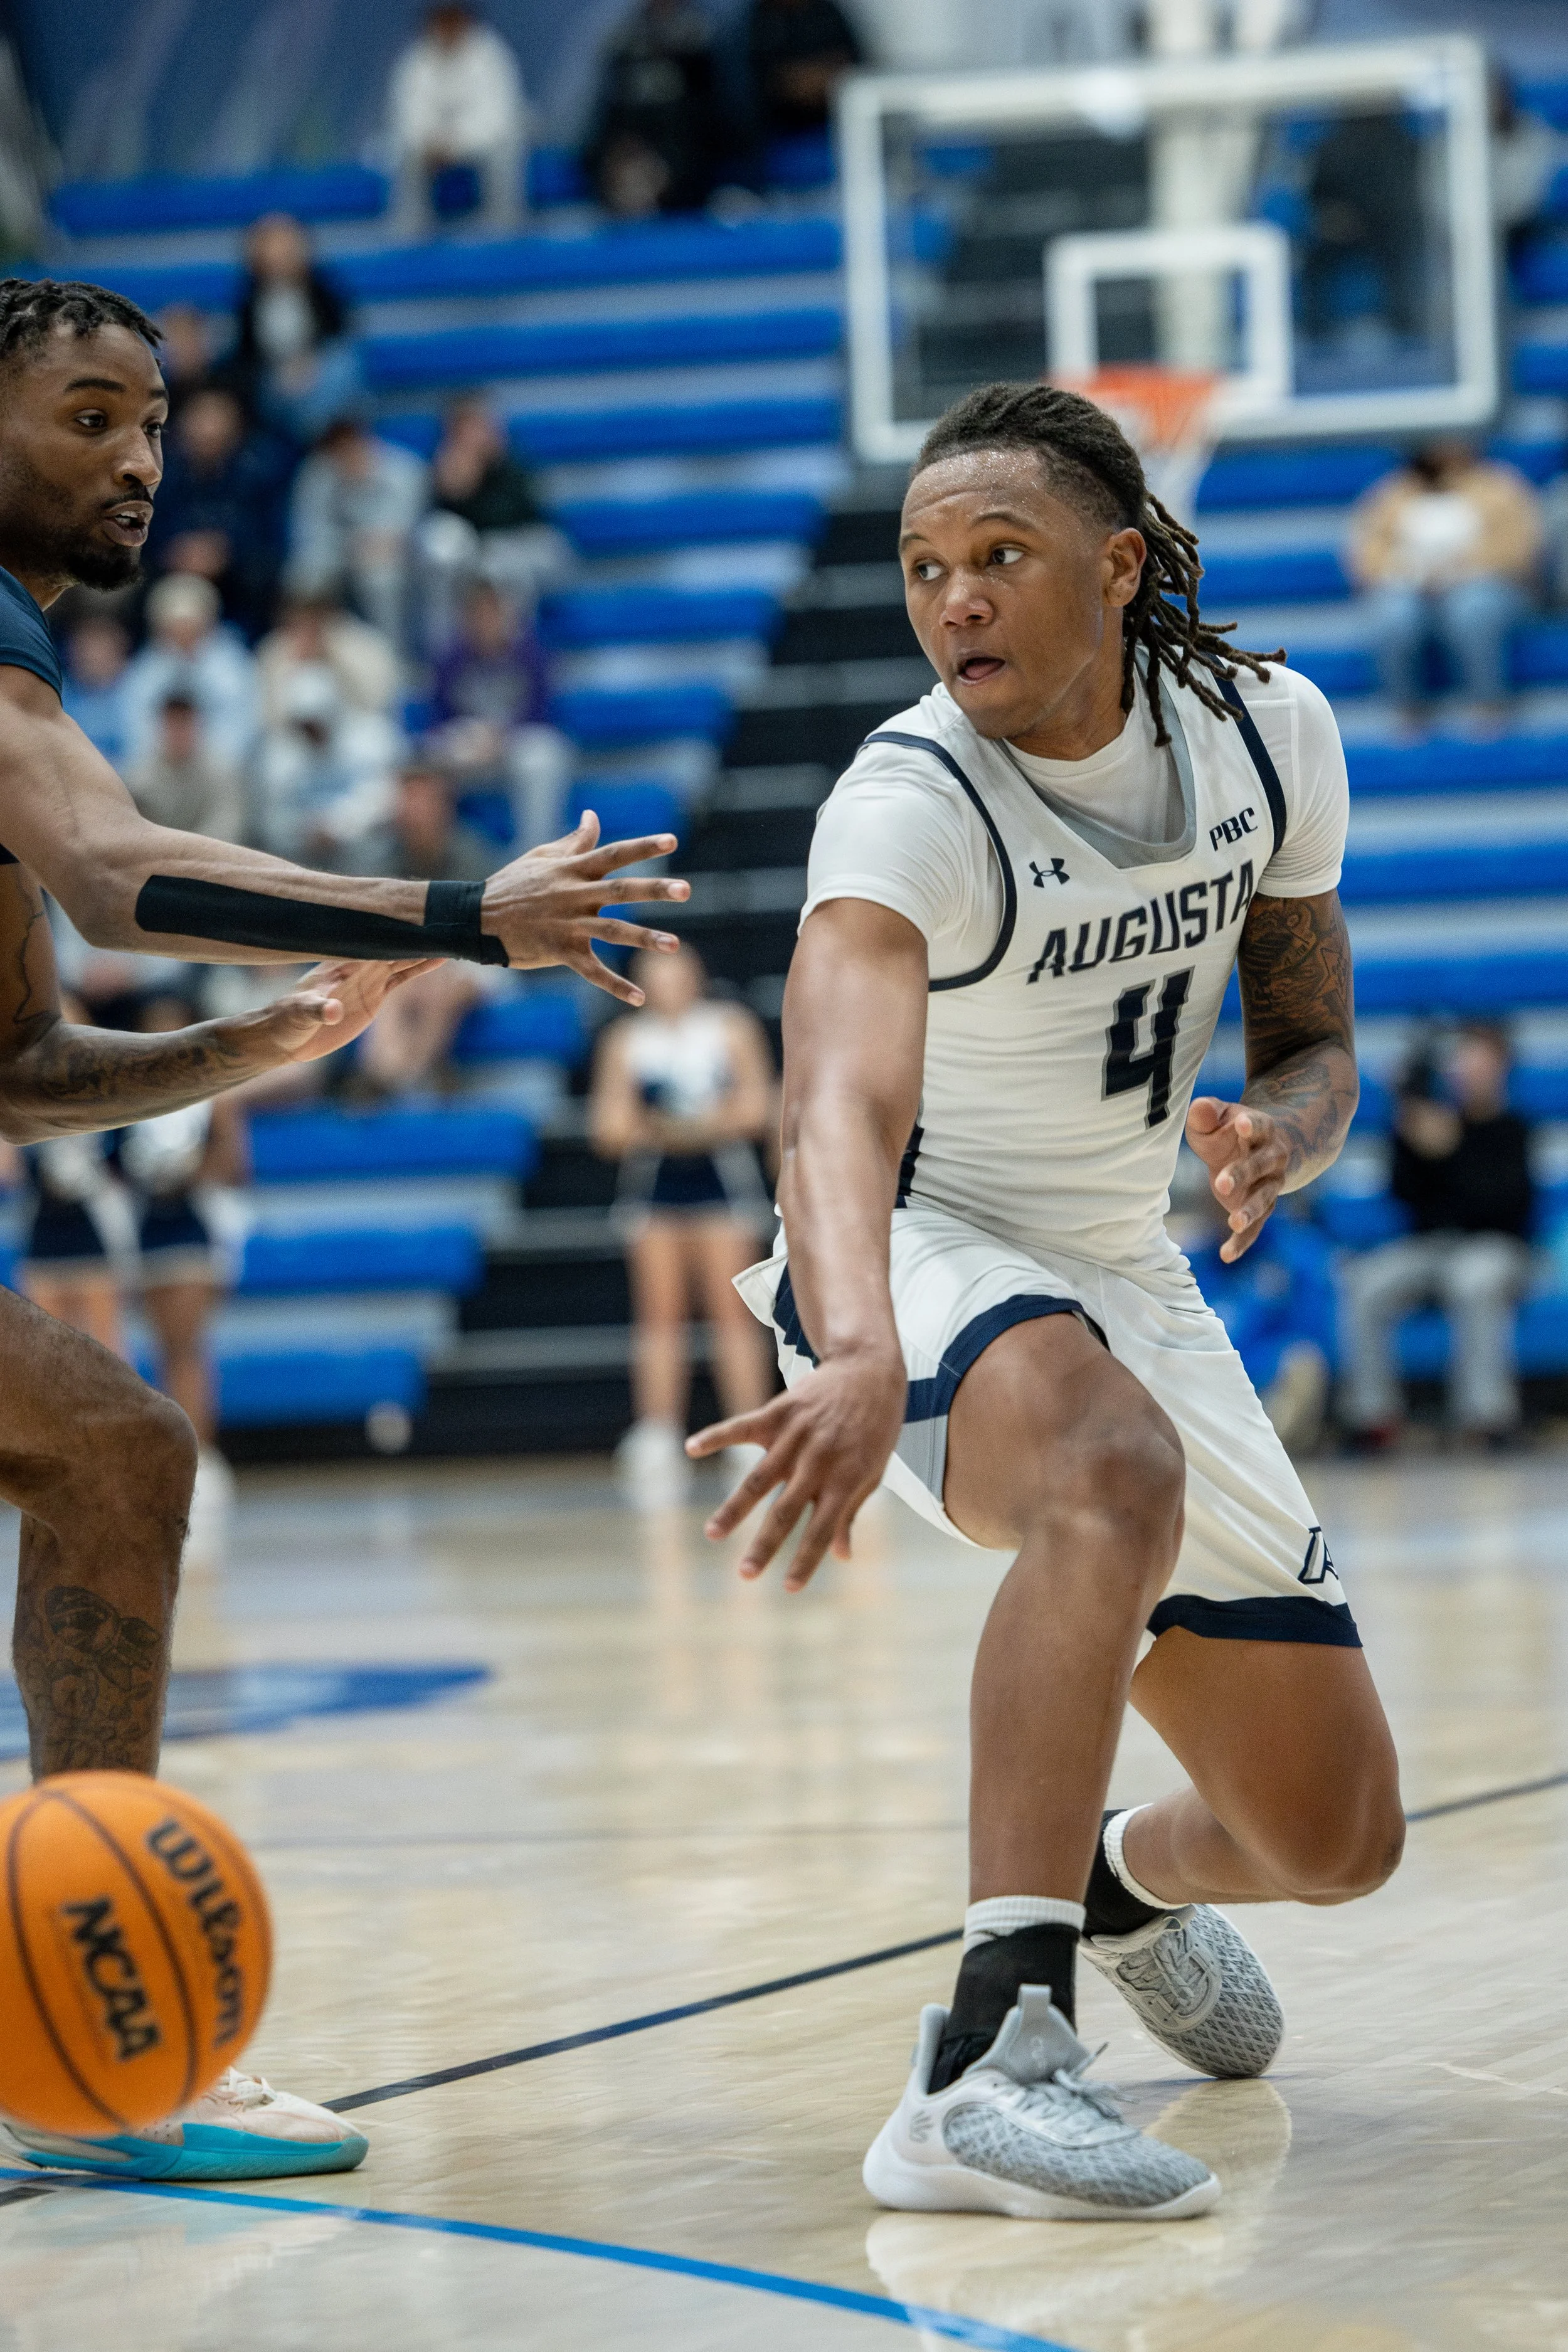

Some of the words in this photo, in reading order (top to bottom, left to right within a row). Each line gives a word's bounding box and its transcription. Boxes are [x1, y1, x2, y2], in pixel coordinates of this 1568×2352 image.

[1209, 807, 1258, 851] PBC
[1027, 859, 1254, 984] AUGUSTA
[1101, 965, 1195, 1130] 4
[63, 1894, 162, 2062] NCAA
